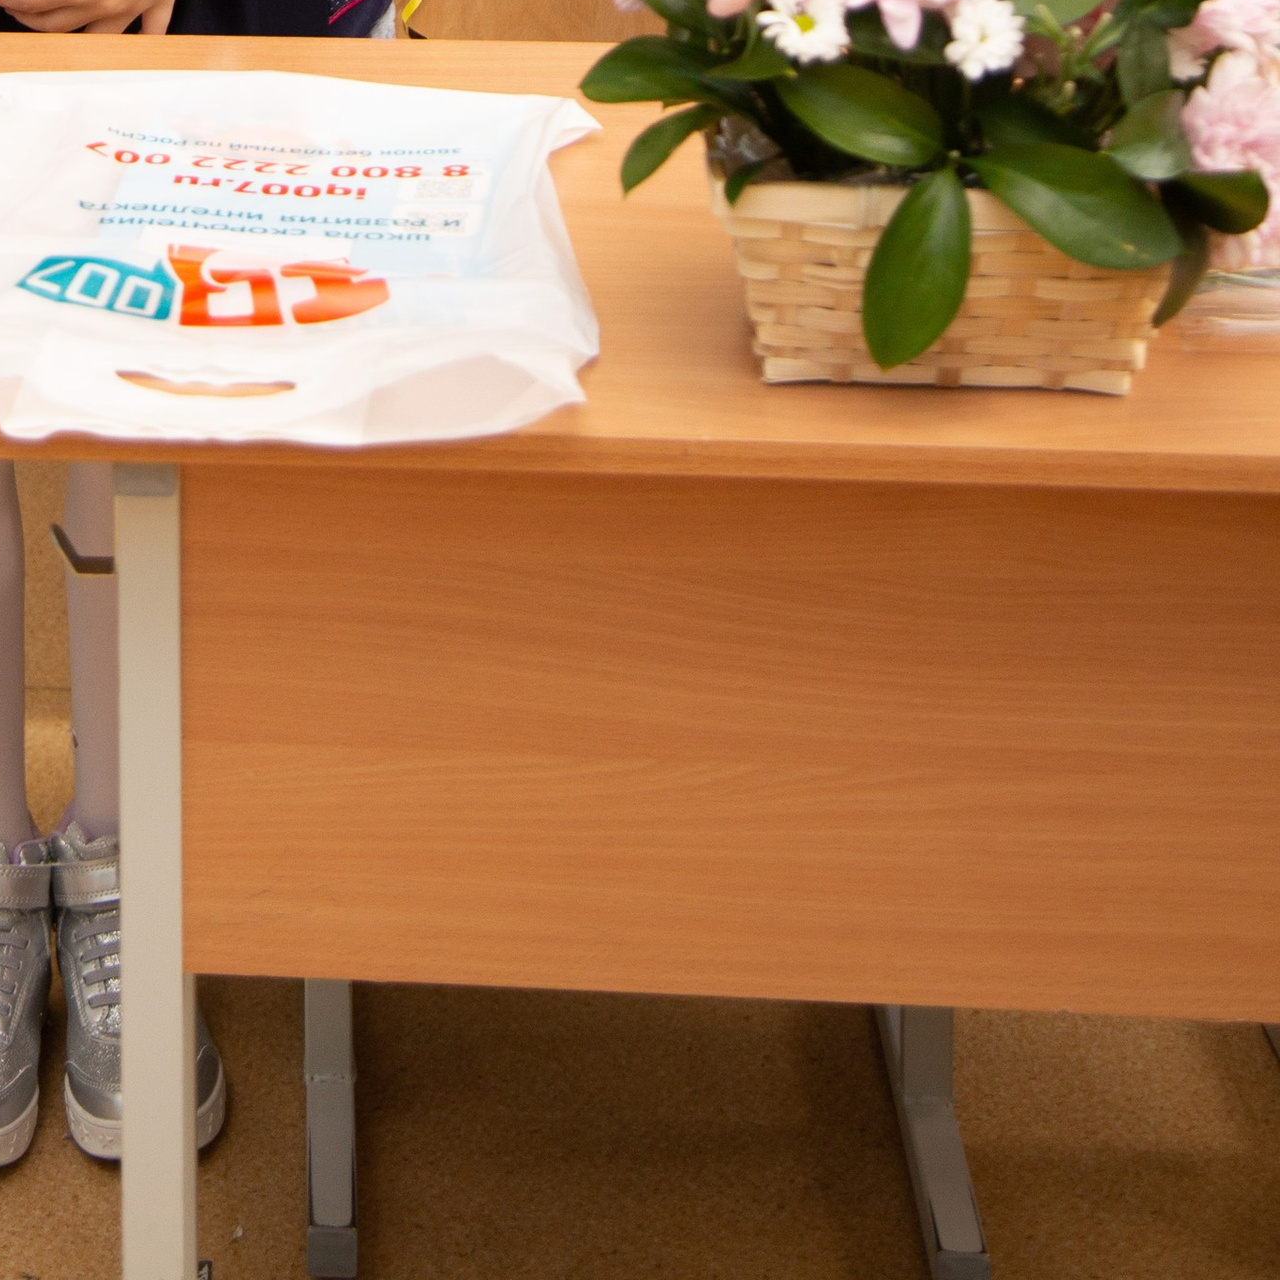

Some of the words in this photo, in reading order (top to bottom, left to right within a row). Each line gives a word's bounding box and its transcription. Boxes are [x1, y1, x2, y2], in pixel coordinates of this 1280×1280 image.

[194, 139, 222, 148] по
[228, 142, 373, 157] бесплатный
[85, 141, 171, 164] 007
[380, 147, 462, 156] звонок
[191, 155, 311, 176] 2222
[330, 165, 423, 178] 800
[442, 164, 471, 177] 8
[173, 174, 367, 200] iq007.ru
[78, 200, 263, 221] интеллекта
[99, 216, 307, 236] скорочтения
[280, 214, 427, 228] развития
[443, 219, 461, 227] и
[323, 230, 431, 241] школа
[25, 260, 164, 318] 007
